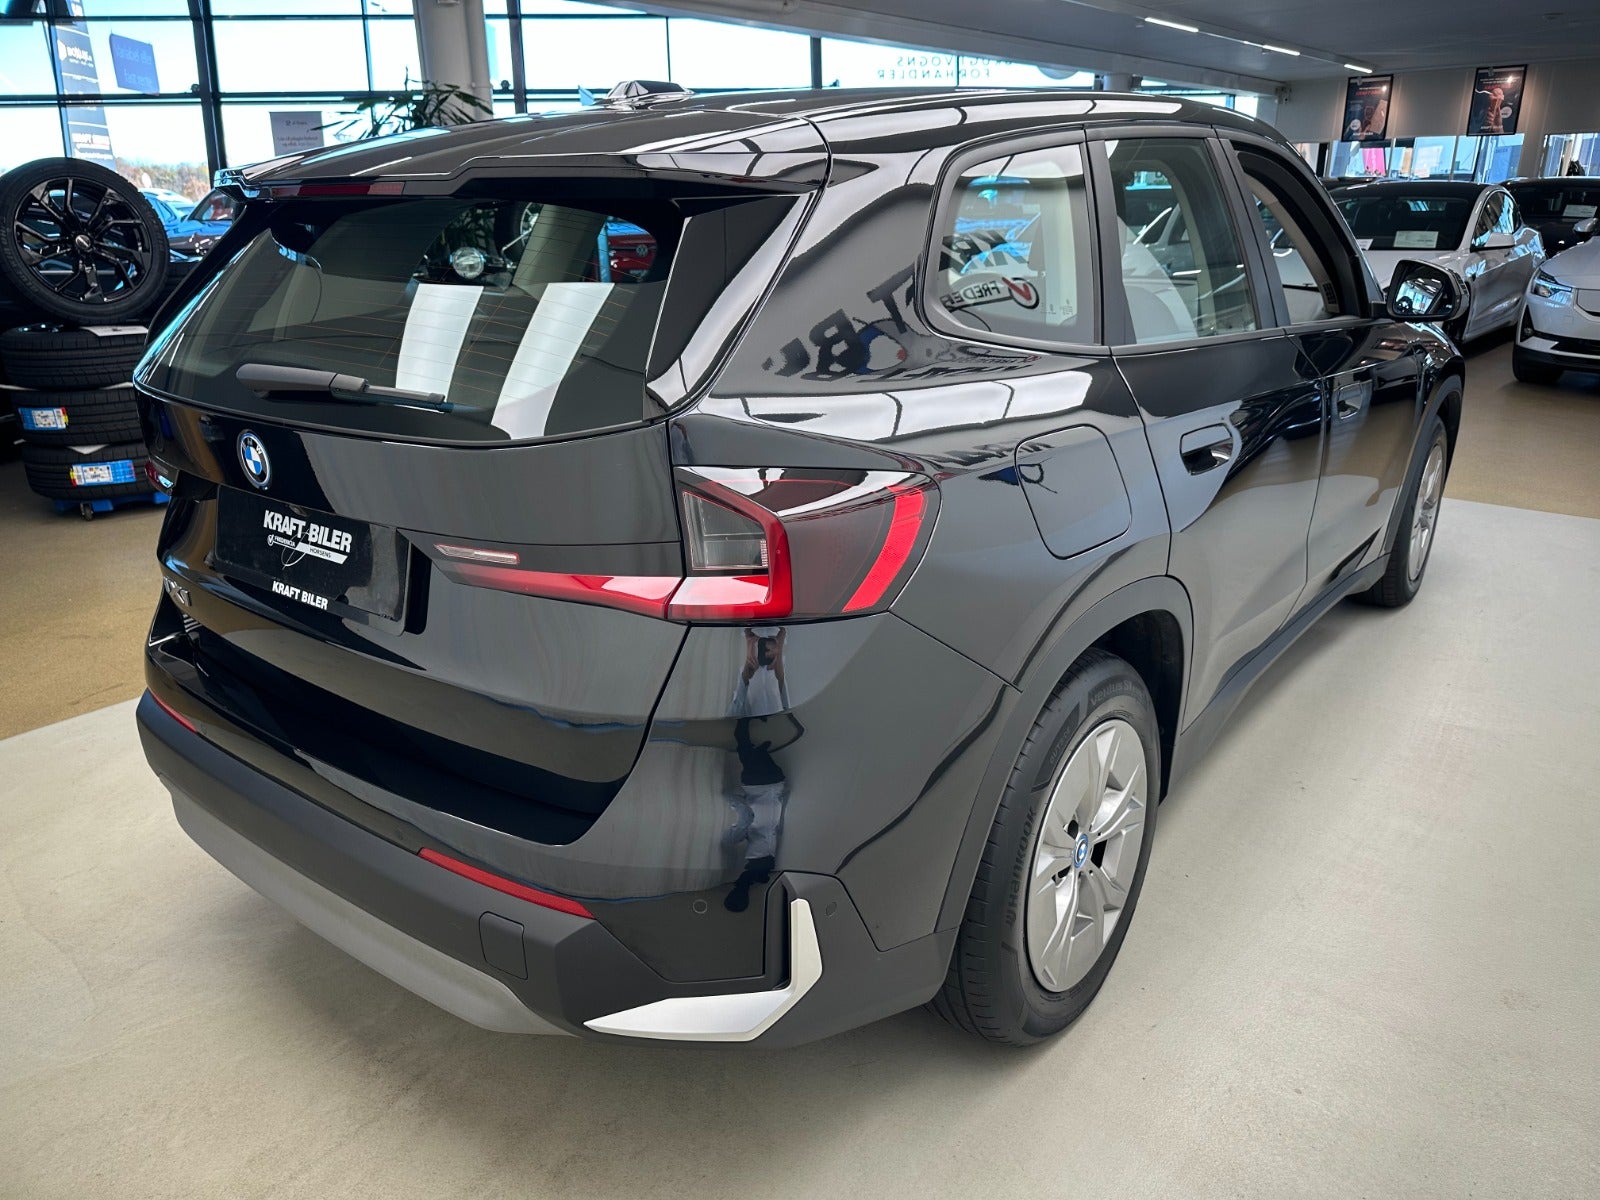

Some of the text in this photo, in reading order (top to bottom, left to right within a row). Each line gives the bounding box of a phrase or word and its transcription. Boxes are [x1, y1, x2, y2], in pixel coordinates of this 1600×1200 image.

[263, 509, 353, 553] KRAFT BILER
[309, 547, 332, 558] HORSENS
[272, 580, 329, 611] KRAFT BILER
